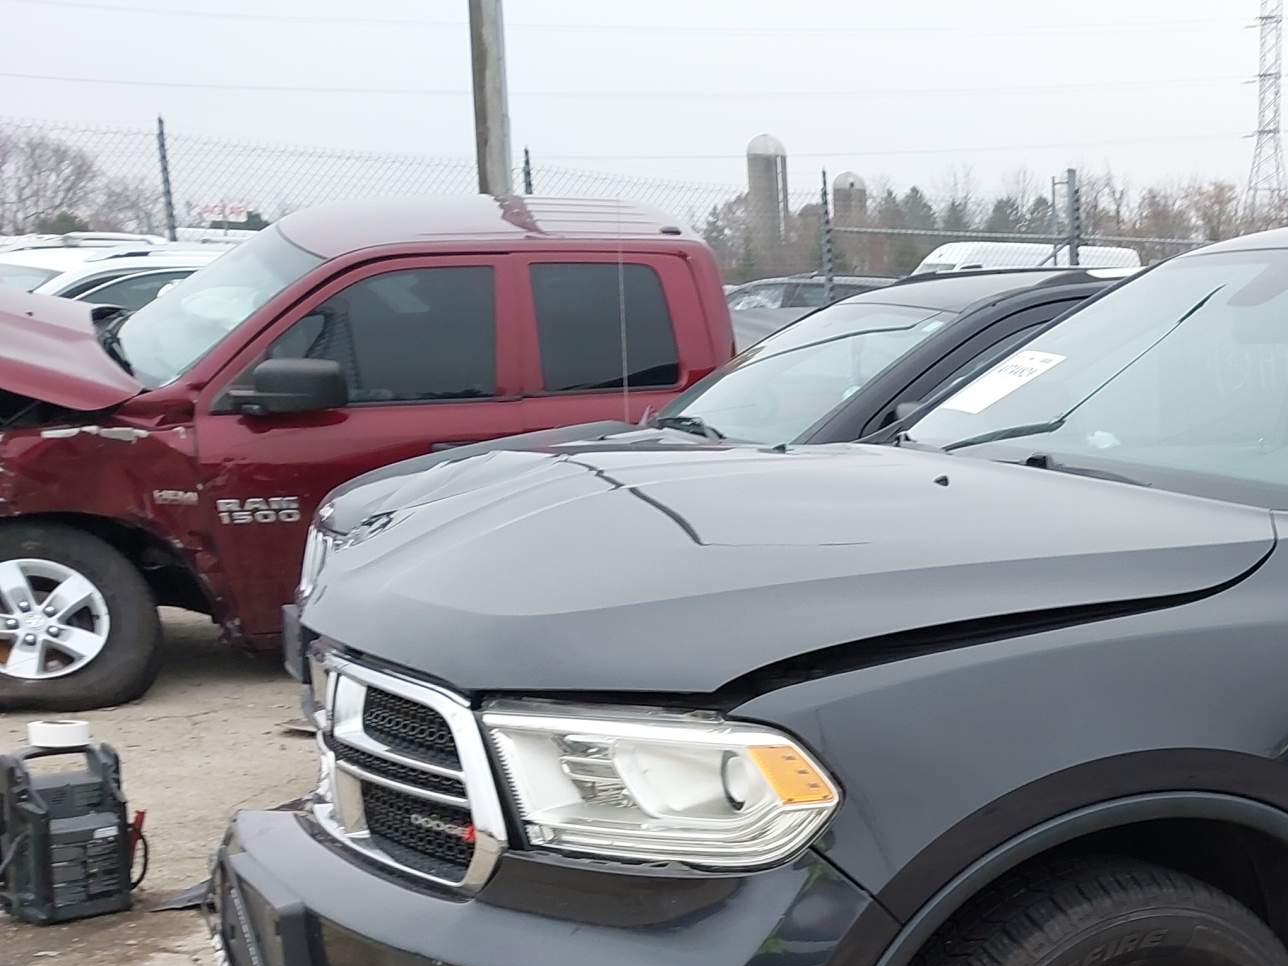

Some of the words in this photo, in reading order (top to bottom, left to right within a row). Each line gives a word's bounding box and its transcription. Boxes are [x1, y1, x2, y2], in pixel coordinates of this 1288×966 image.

[215, 497, 299, 512] RAM
[218, 510, 300, 524] 1500
[410, 814, 470, 838] DODGE
